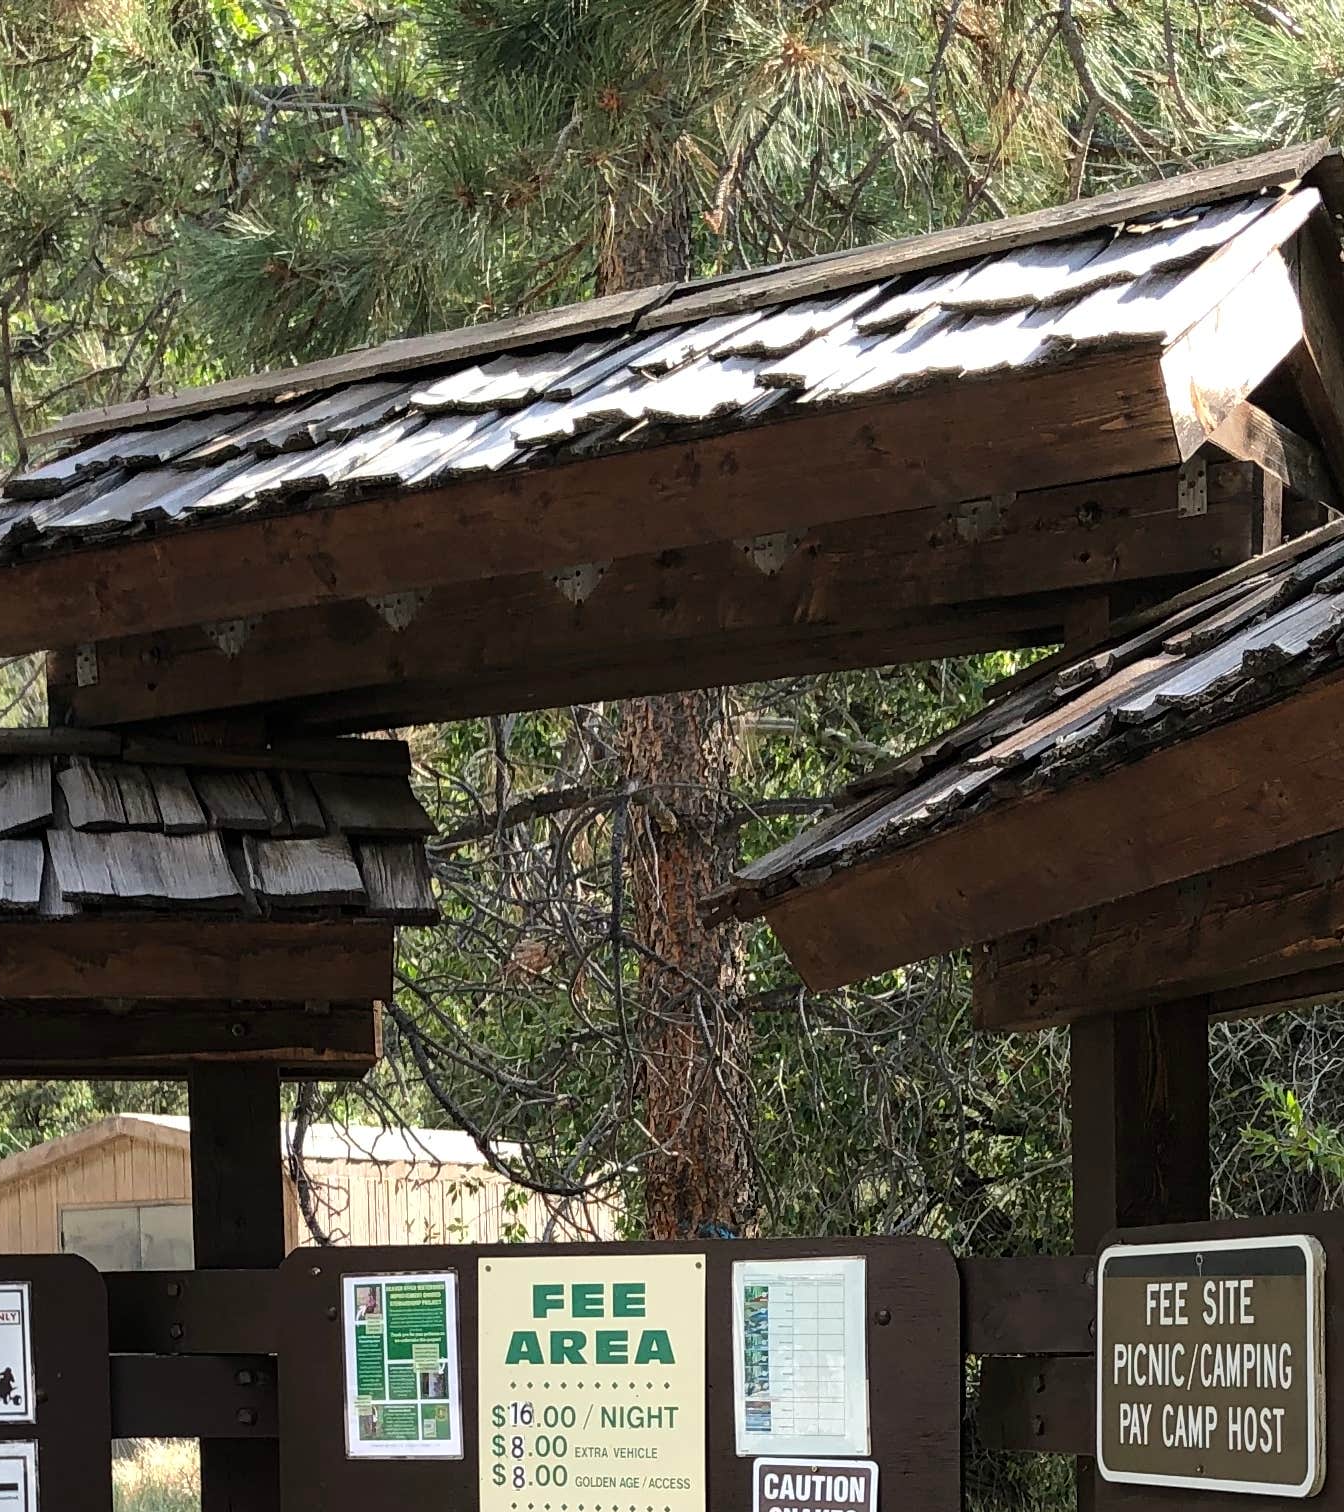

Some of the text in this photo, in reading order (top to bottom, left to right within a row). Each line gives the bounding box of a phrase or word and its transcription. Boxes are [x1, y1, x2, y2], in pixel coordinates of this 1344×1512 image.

[533, 1283, 645, 1318] FEE
[1147, 1280, 1254, 1325] FEE SITE
[505, 1330, 675, 1364] AREA
[1114, 1342, 1292, 1390] PICNIC/CAMPING
[492, 1402, 679, 1430] $16.00 / NIGHT
[1120, 1403, 1285, 1453] PAY CAMP HOST
[492, 1434, 658, 1459] $8.00 EXTRA VEHICLE
[492, 1463, 568, 1488] $8.00
[575, 1476, 616, 1488] GOLDEN
[619, 1477, 640, 1488] AGE
[648, 1478, 690, 1489] ACCESS
[764, 1473, 865, 1502] CAUTION
